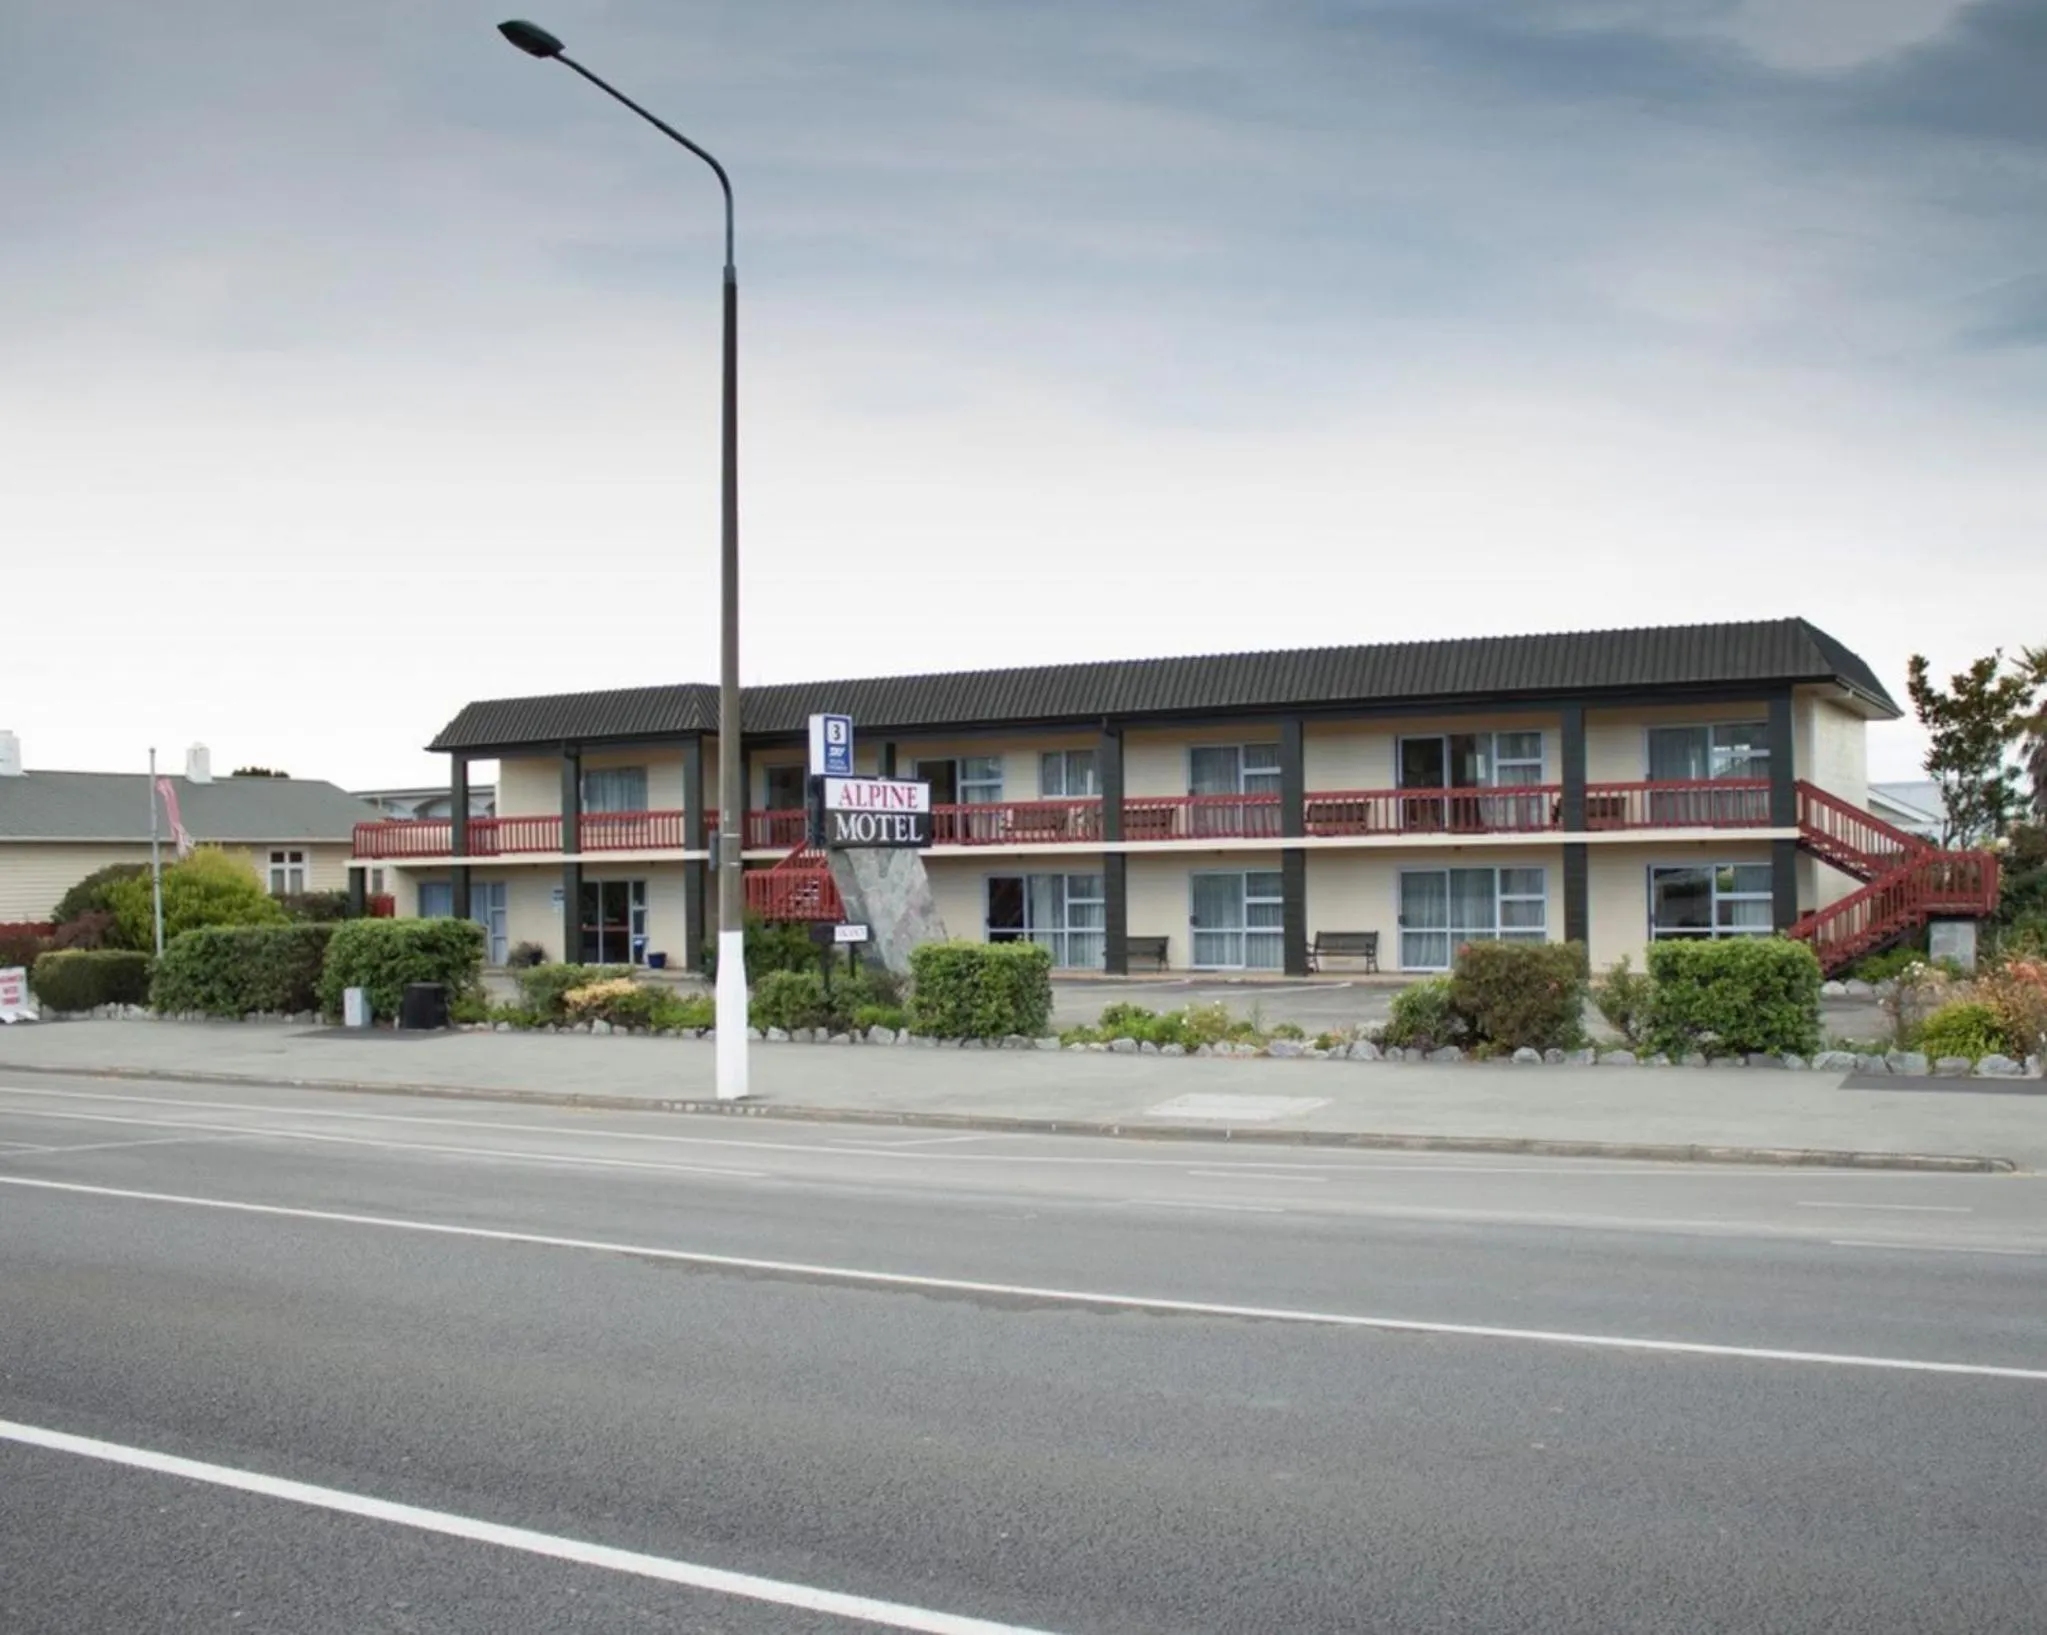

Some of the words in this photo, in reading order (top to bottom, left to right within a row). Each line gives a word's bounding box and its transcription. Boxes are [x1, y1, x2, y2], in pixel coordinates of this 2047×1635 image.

[832, 724, 841, 741] 3
[838, 783, 919, 809] ALPINE
[834, 812, 924, 842] MOTEL
